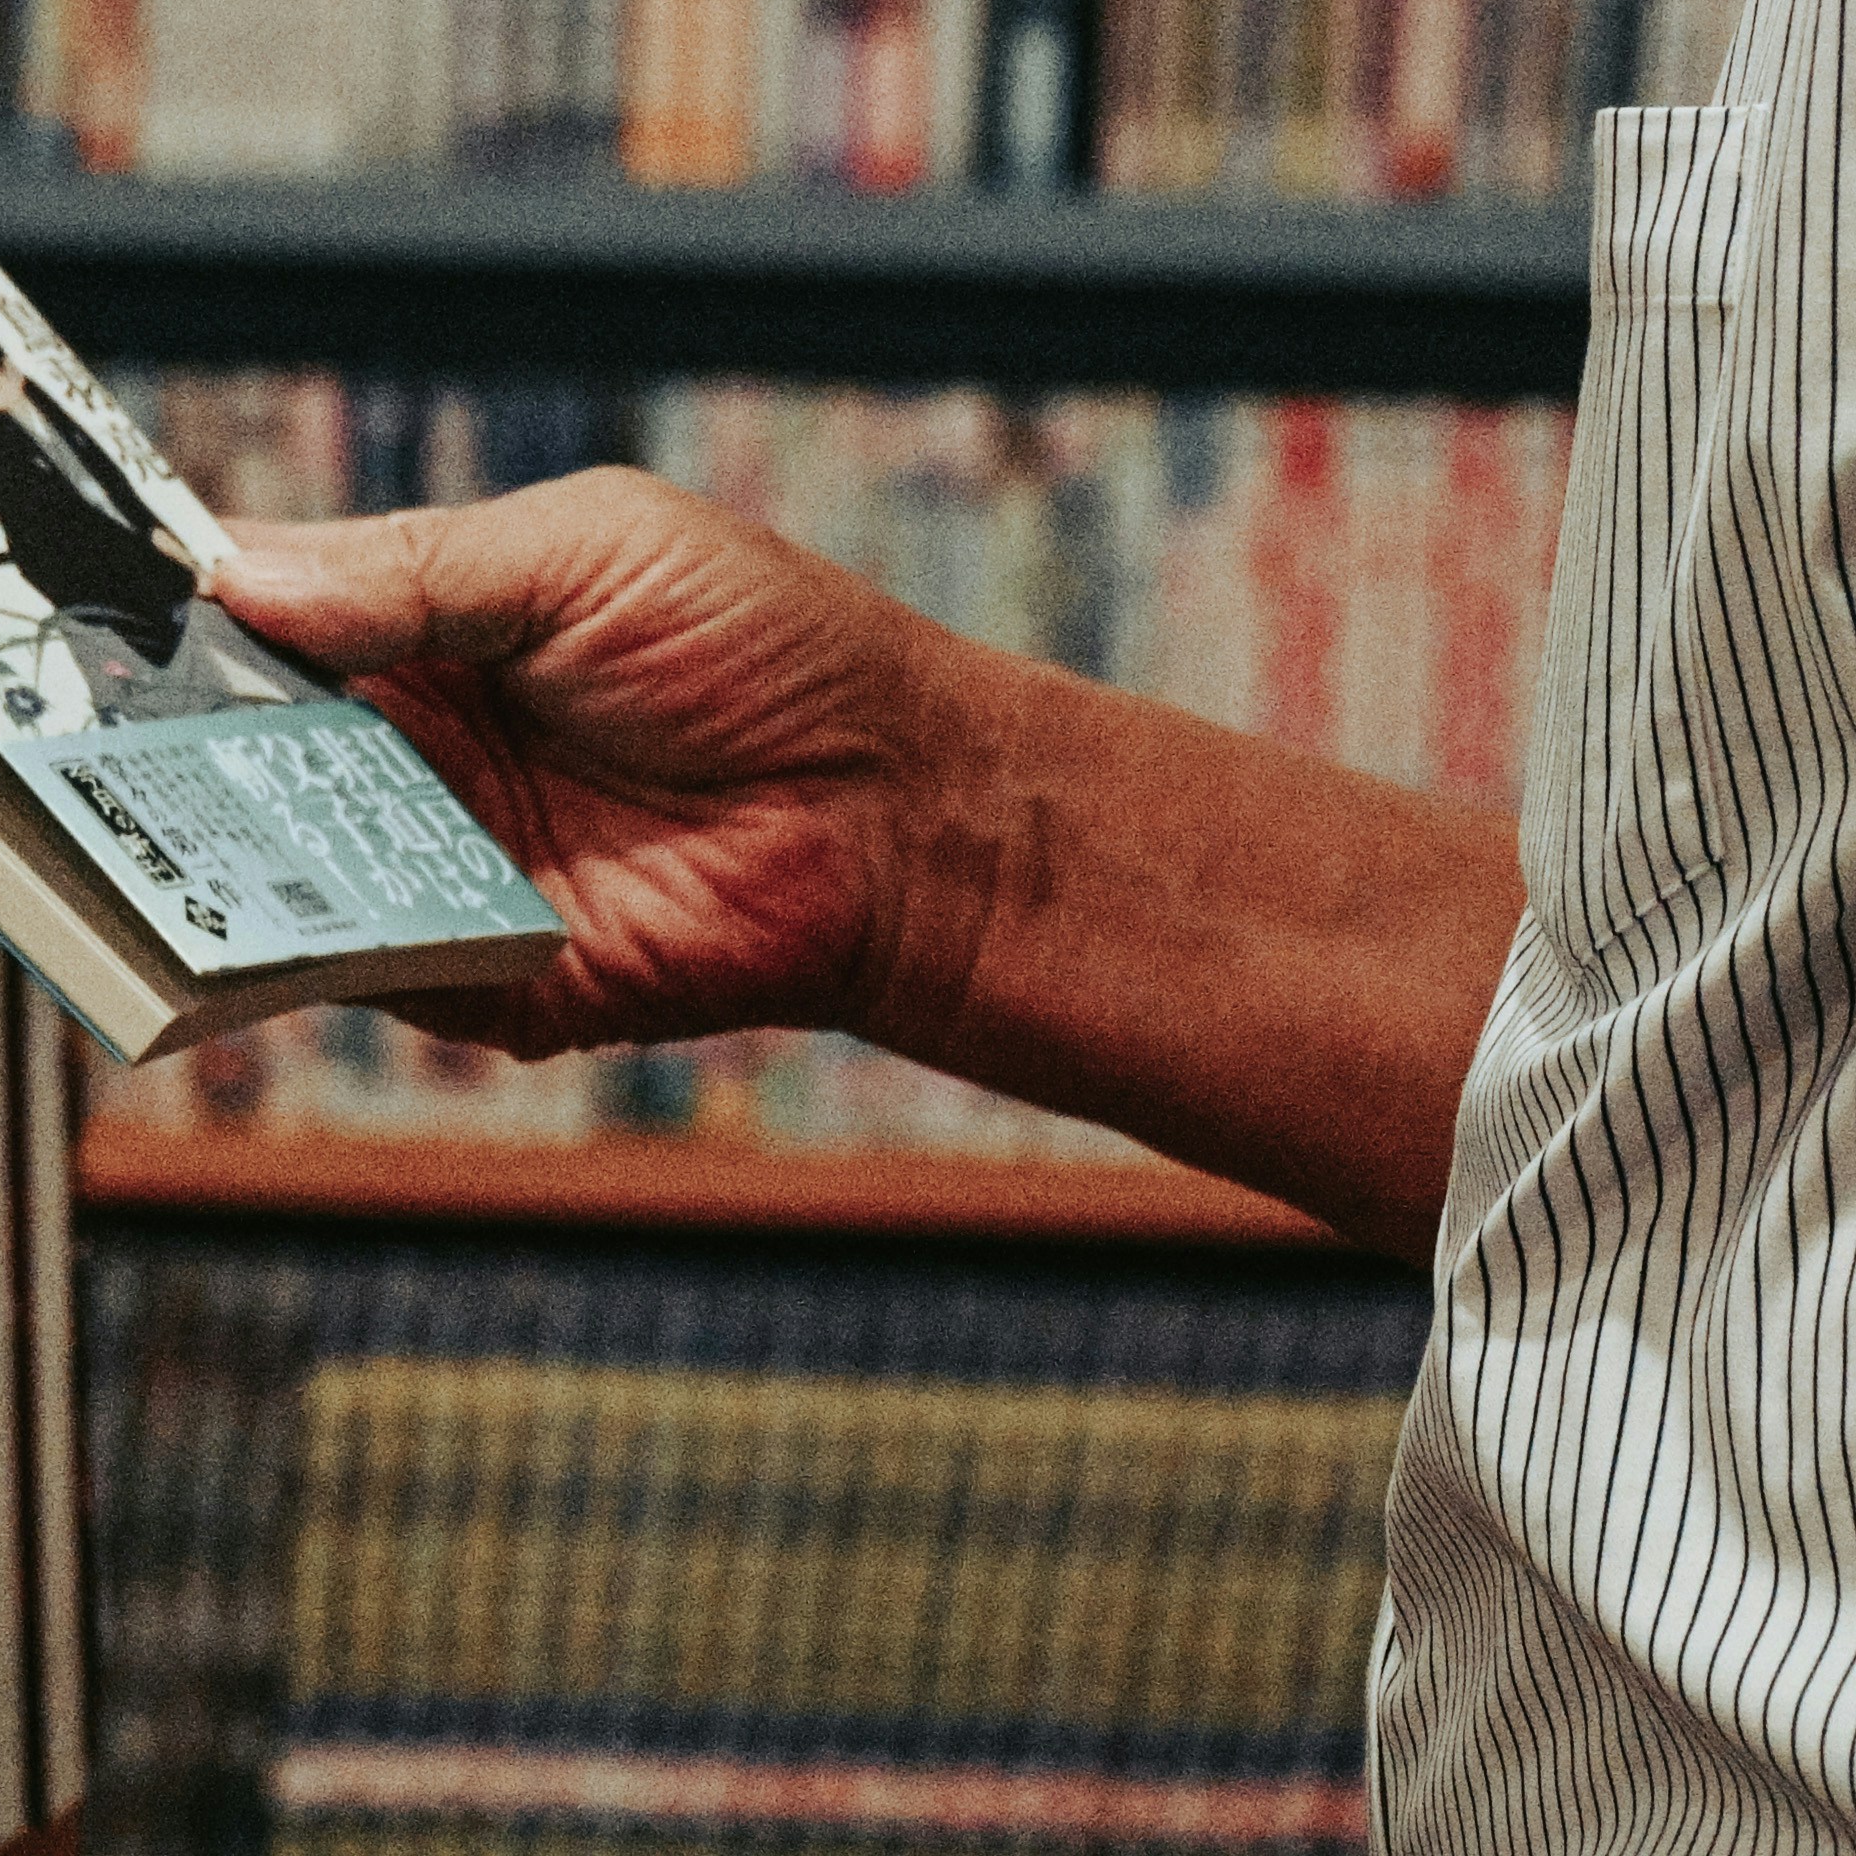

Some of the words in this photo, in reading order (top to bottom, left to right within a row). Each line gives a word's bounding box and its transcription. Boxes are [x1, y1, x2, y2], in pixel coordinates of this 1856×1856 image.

[261, 733, 421, 909] 父子が
[309, 727, 512, 930] 非道は、
[359, 723, 514, 885] 江戸の
